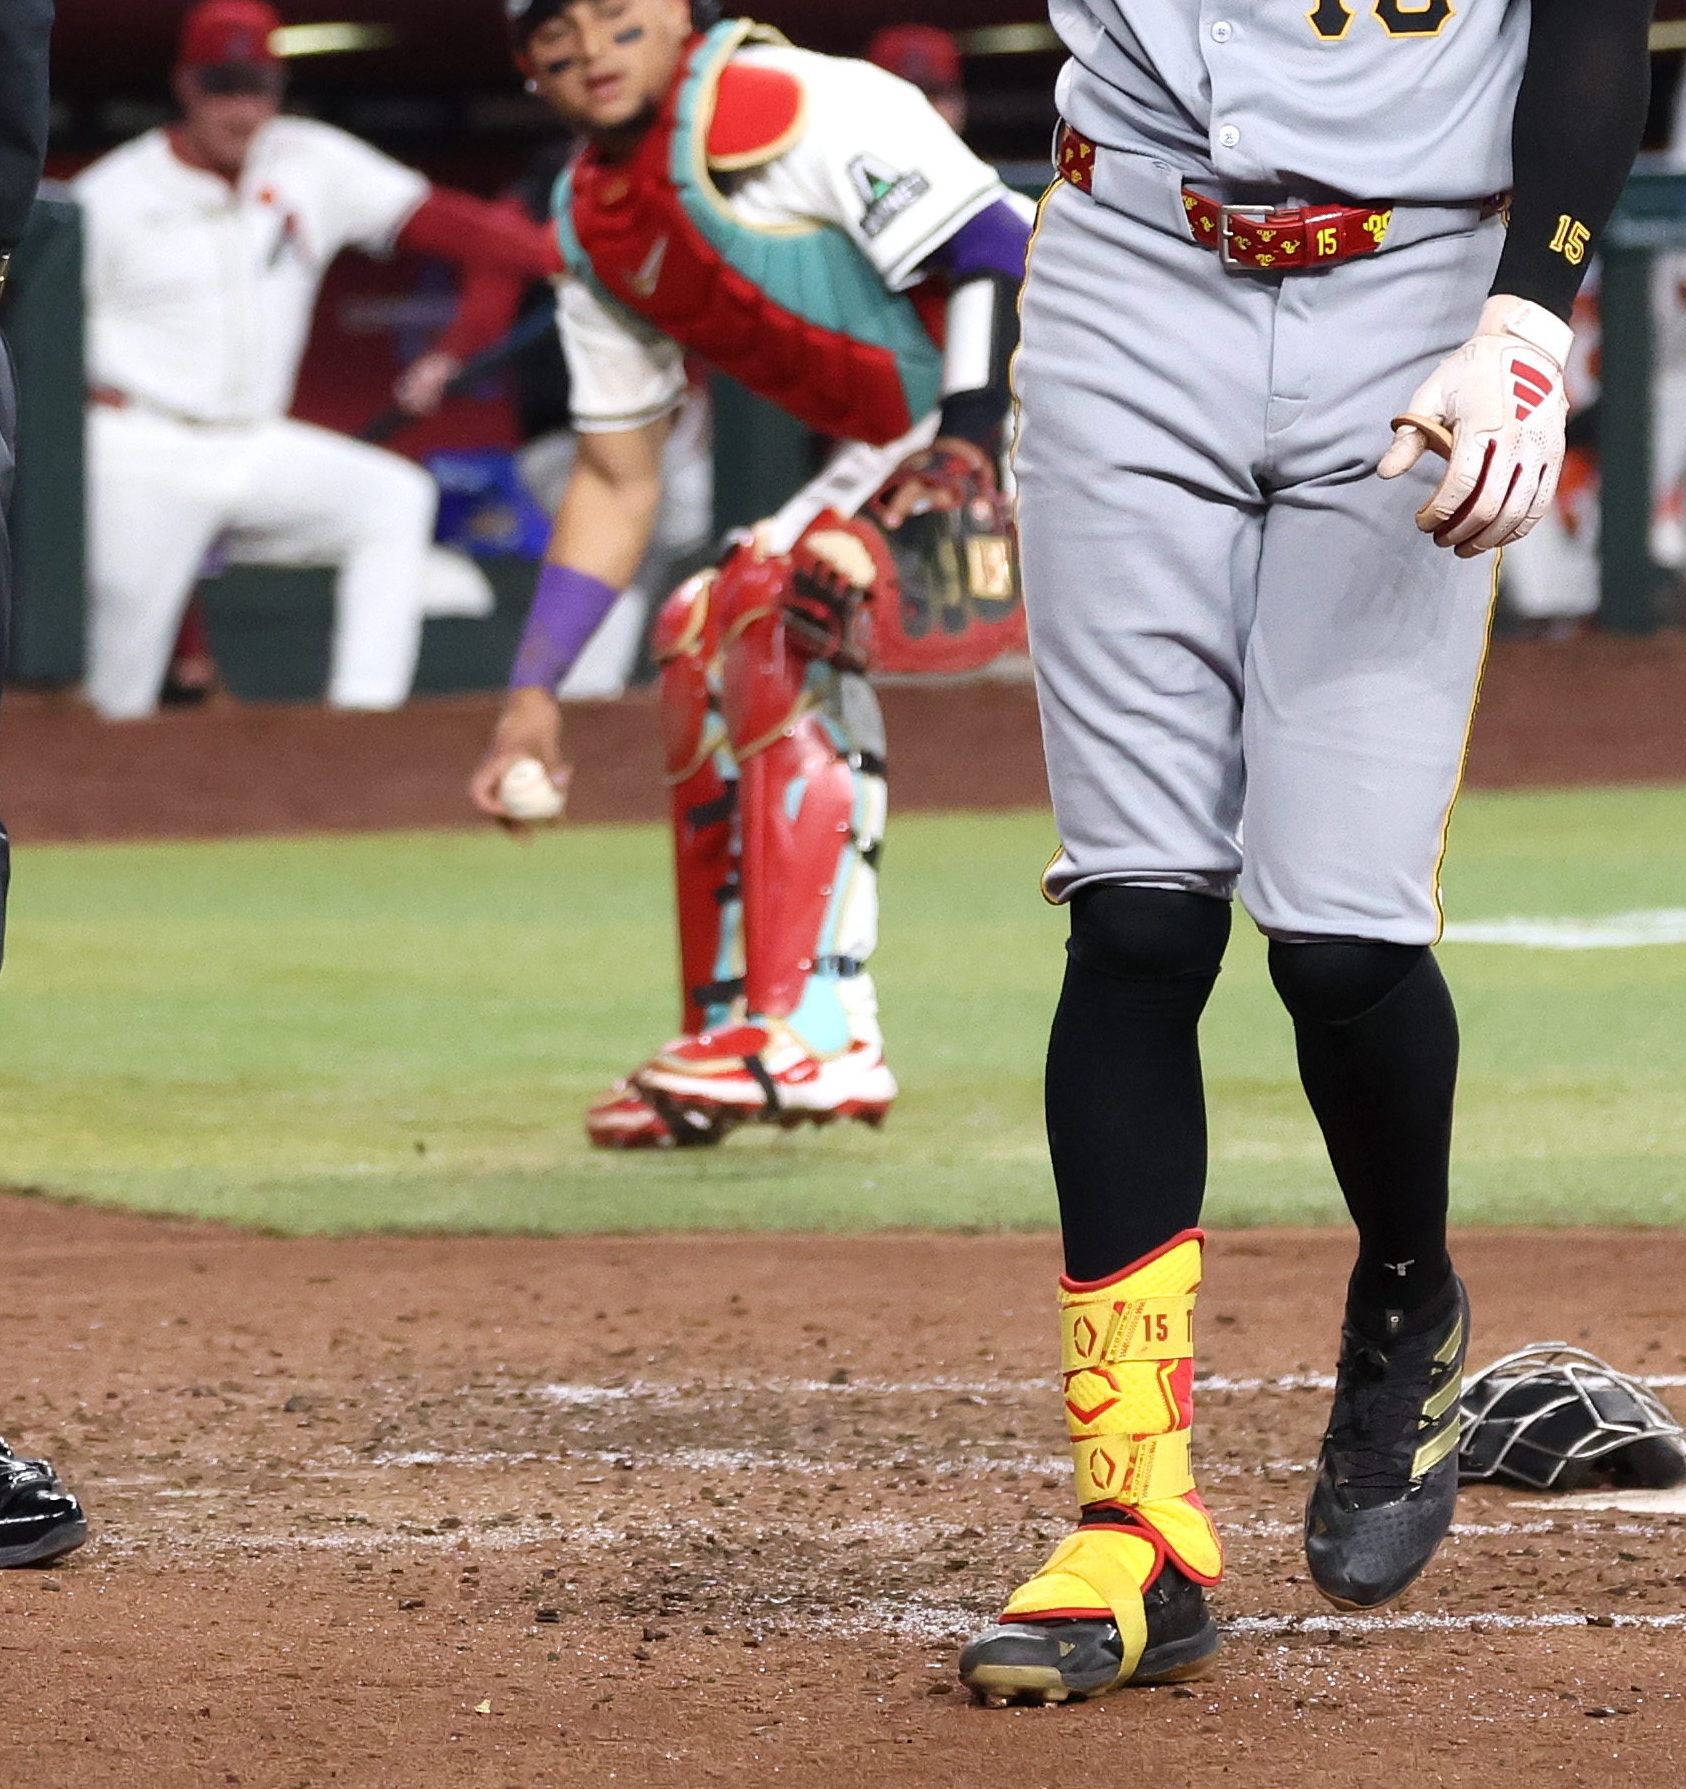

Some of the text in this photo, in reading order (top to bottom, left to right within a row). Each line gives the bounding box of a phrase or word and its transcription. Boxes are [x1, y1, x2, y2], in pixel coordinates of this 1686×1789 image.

[1316, 227, 1338, 256] 15
[1549, 214, 1591, 265] 15
[1143, 1313, 1168, 1342] 15
